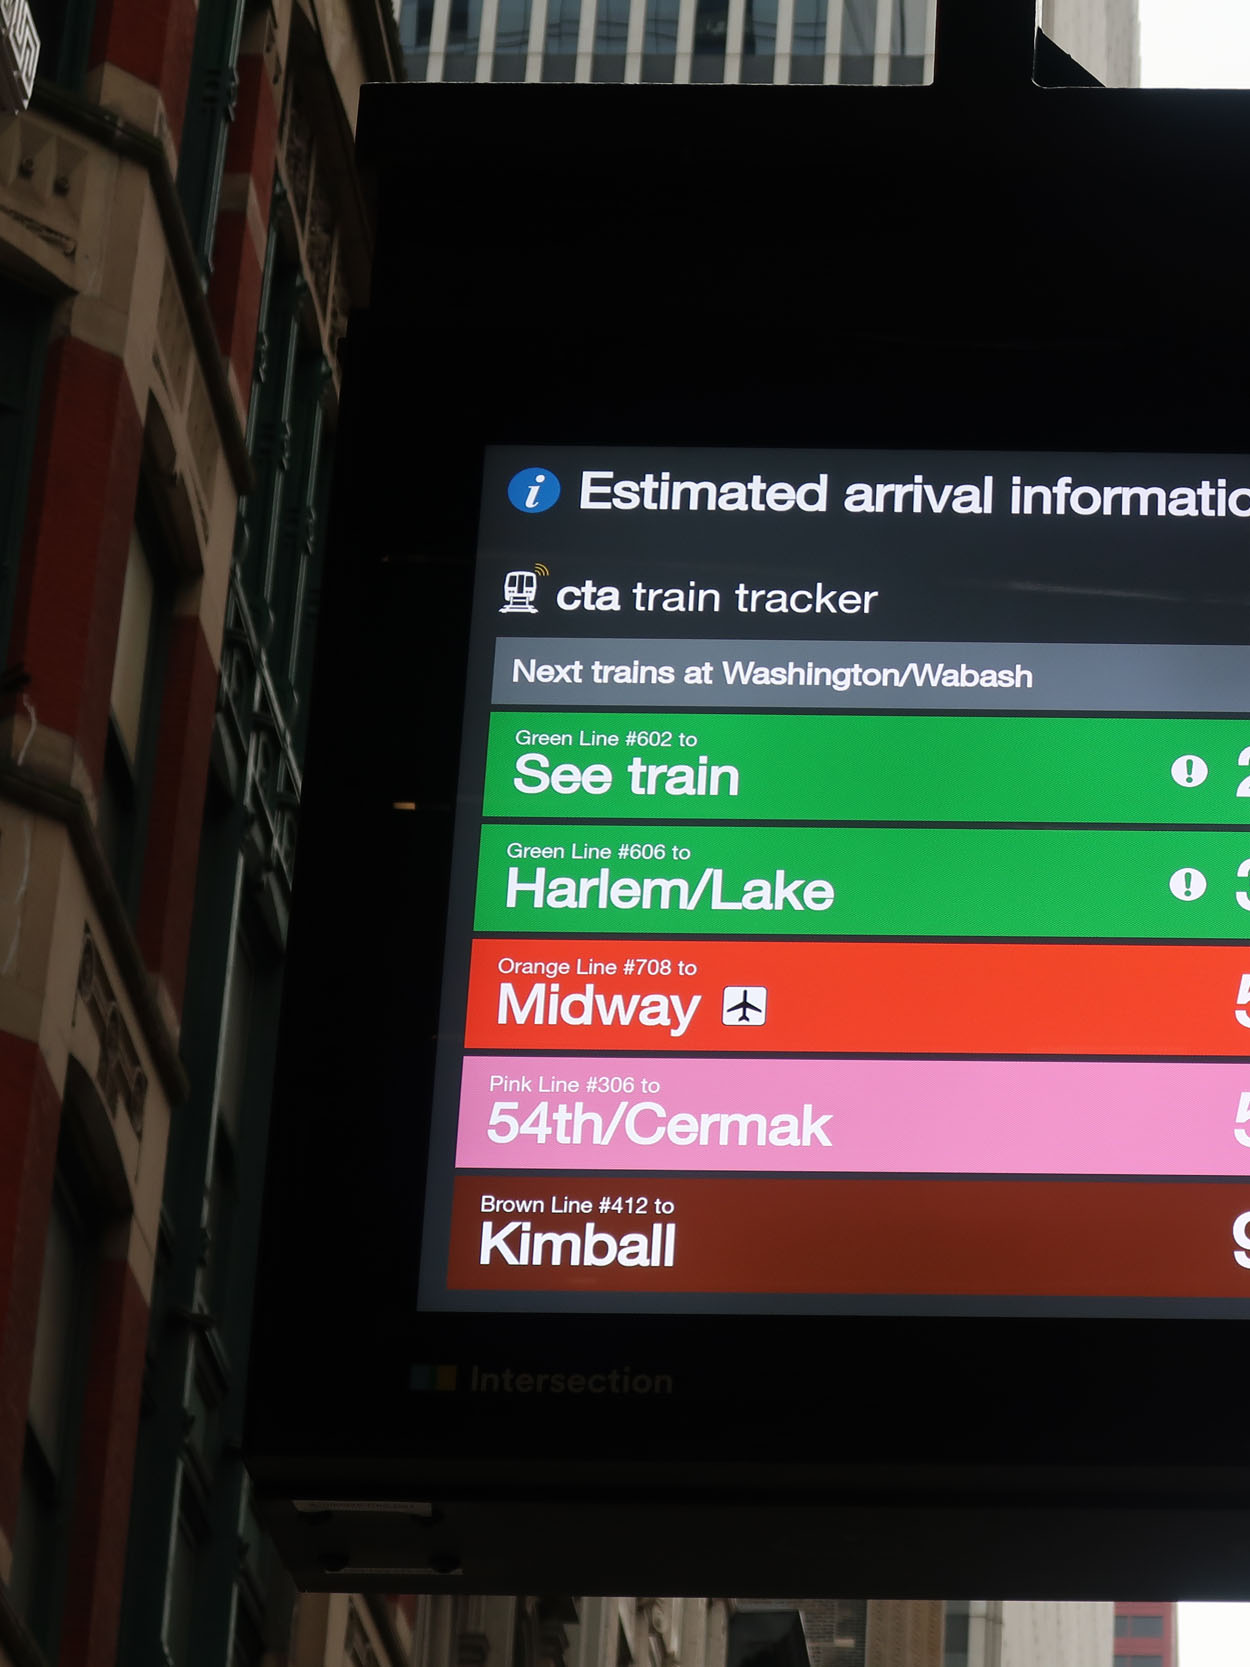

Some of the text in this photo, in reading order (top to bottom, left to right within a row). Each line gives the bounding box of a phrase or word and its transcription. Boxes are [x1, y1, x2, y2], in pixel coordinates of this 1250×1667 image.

[580, 470, 829, 512] Estimated
[843, 474, 994, 514] arrival
[556, 579, 879, 614] cta train tracker
[512, 658, 1033, 692] Next trains at Washington/Wabash
[515, 729, 698, 748] Green Line #602 to
[513, 752, 740, 796] See train
[506, 842, 691, 861] Green Line #606 to
[506, 866, 835, 911] Harlem/Lake
[498, 957, 698, 979] Orange Line #708 to
[497, 982, 702, 1037] Midway
[488, 1075, 661, 1094] Pink Line #306 to
[487, 1101, 834, 1147] 54th/Cermak
[480, 1195, 675, 1215] Brown Line #412 to
[479, 1221, 676, 1267] Kimball
[470, 1365, 673, 1393] Intersection
